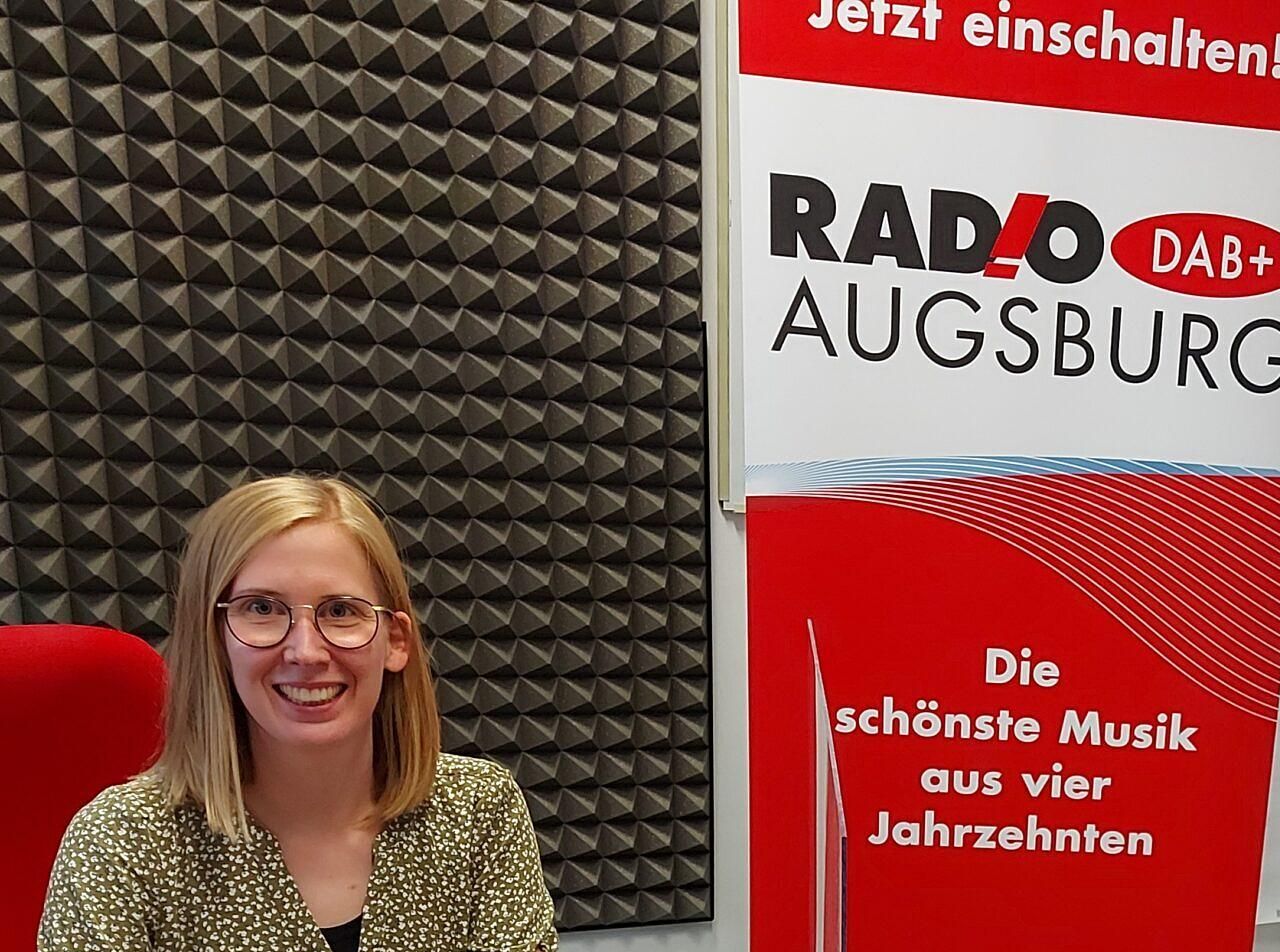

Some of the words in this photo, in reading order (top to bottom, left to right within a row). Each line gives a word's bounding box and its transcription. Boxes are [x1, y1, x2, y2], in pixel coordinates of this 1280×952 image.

[808, 0, 942, 41] Jetzt
[1152, 228, 1275, 280] DAB+
[985, 647, 1060, 687] Die
[835, 696, 1041, 743] schönste
[1058, 709, 1199, 751] Musik
[920, 768, 1003, 796] aus
[1021, 762, 1112, 801] vier
[867, 809, 1153, 856] Jahrzehnten
